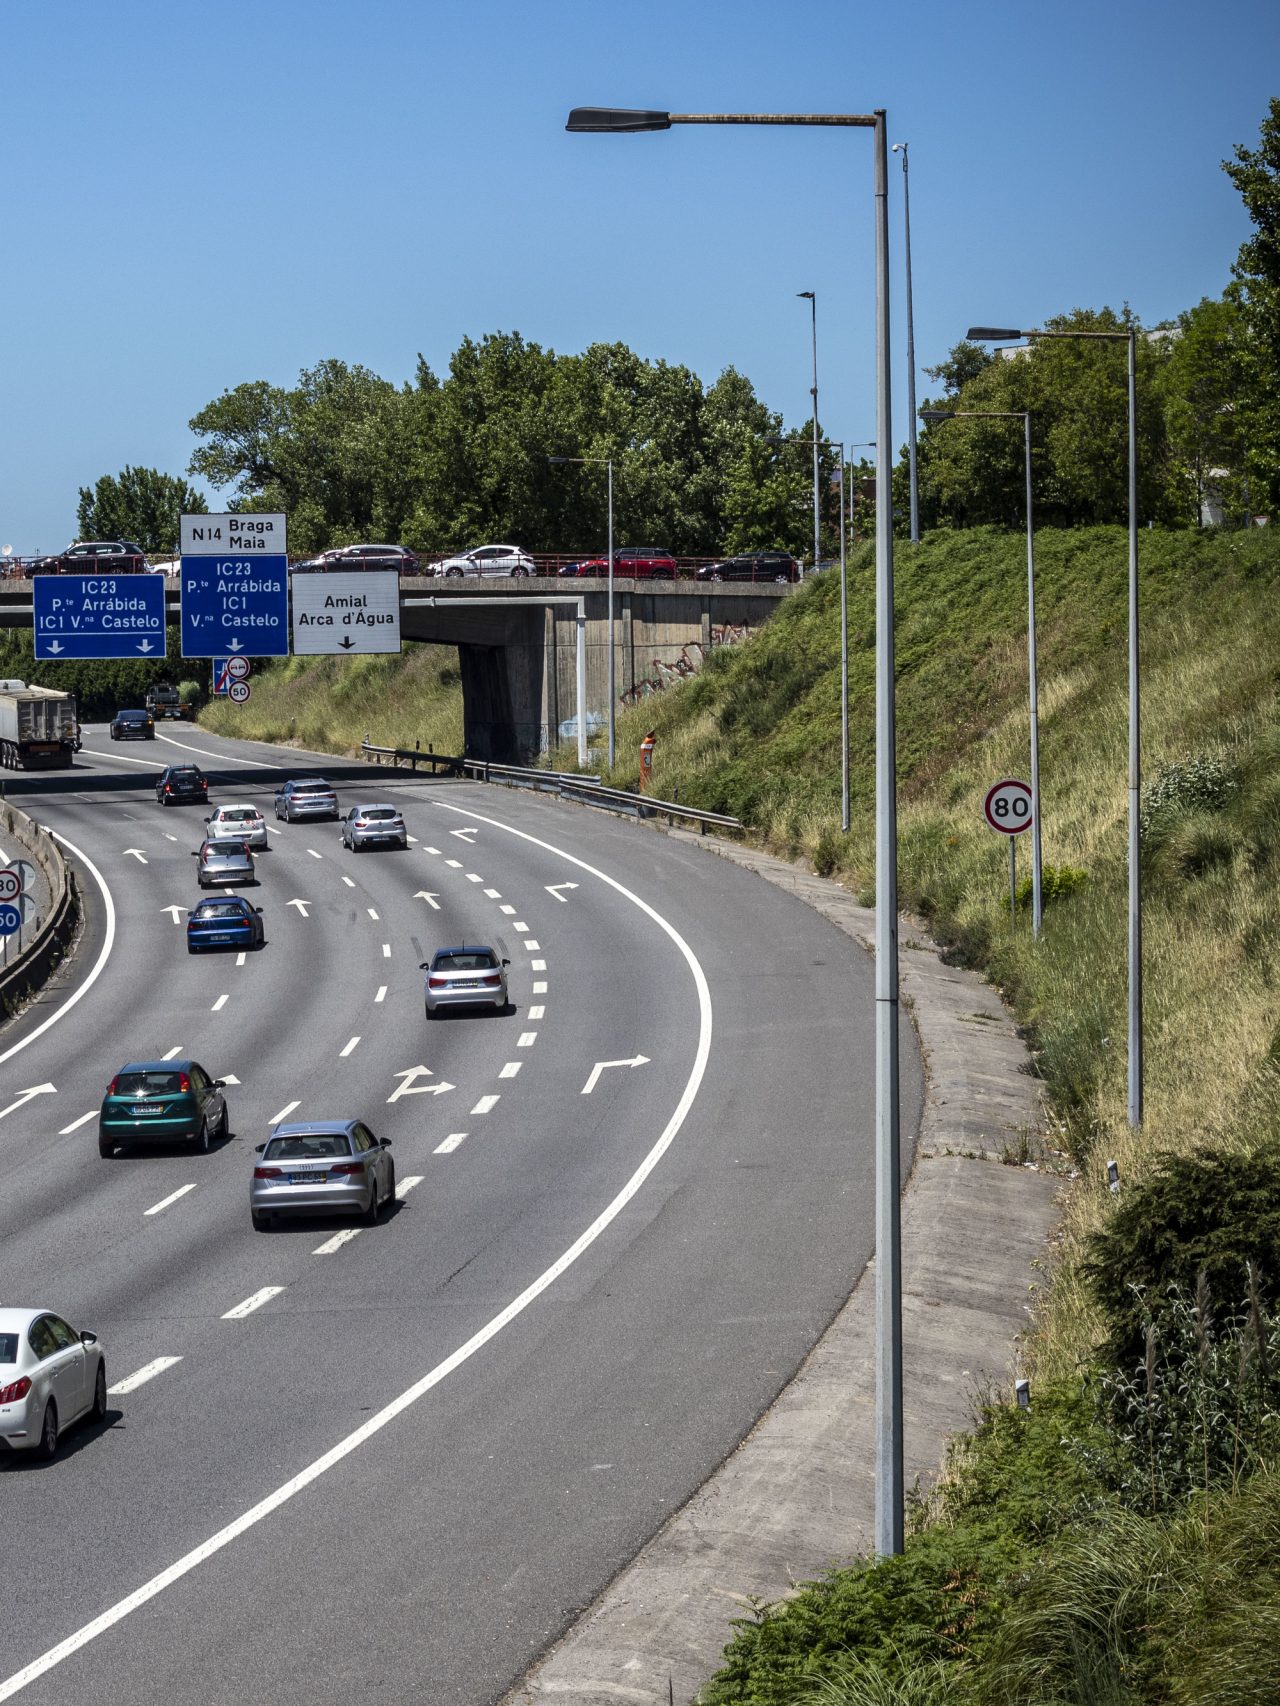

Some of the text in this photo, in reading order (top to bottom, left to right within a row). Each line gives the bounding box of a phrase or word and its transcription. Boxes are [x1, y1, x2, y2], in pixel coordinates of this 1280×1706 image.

[229, 519, 274, 533] Braga
[192, 528, 222, 541] N14
[229, 536, 266, 549] Maia
[216, 562, 251, 575] IC23
[81, 581, 117, 594] IC23
[216, 579, 281, 593] Arrábida
[82, 597, 146, 611] Arrábida
[223, 597, 246, 610] IC1
[324, 595, 368, 608] Amial
[39, 616, 63, 629] IC1
[101, 614, 160, 628] Castelo
[221, 613, 279, 627] Castelo
[298, 608, 394, 627] Arca d'Água
[233, 687, 247, 697] 50
[994, 797, 1028, 817] 80
